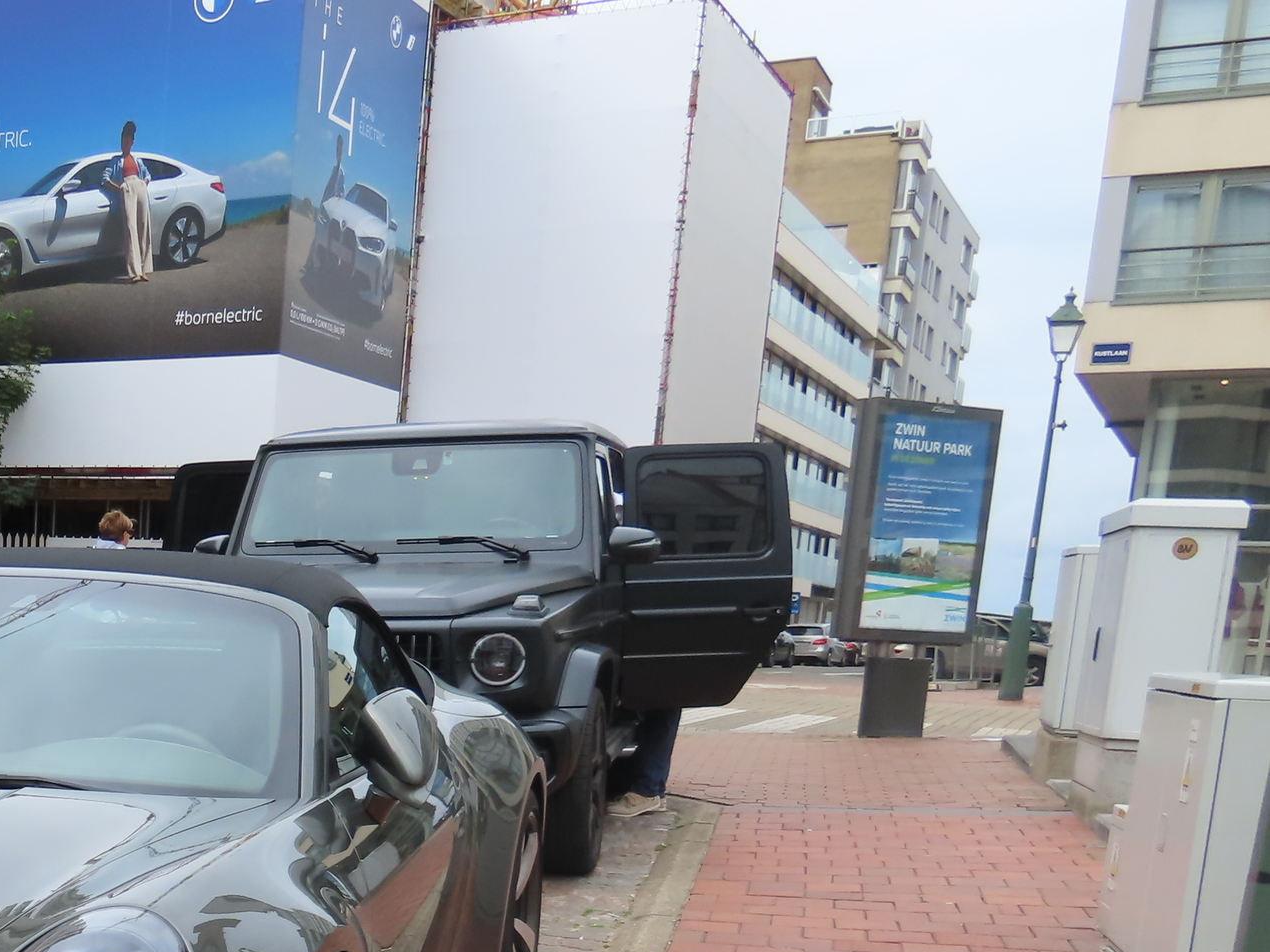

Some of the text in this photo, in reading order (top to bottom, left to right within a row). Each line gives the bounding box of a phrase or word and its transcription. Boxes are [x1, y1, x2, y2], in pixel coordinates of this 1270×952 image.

[318, 23, 357, 157] i4
[175, 305, 264, 326] #bornelectric
[895, 422, 926, 437] ZWIN
[892, 438, 973, 457] NATUUR PARK
